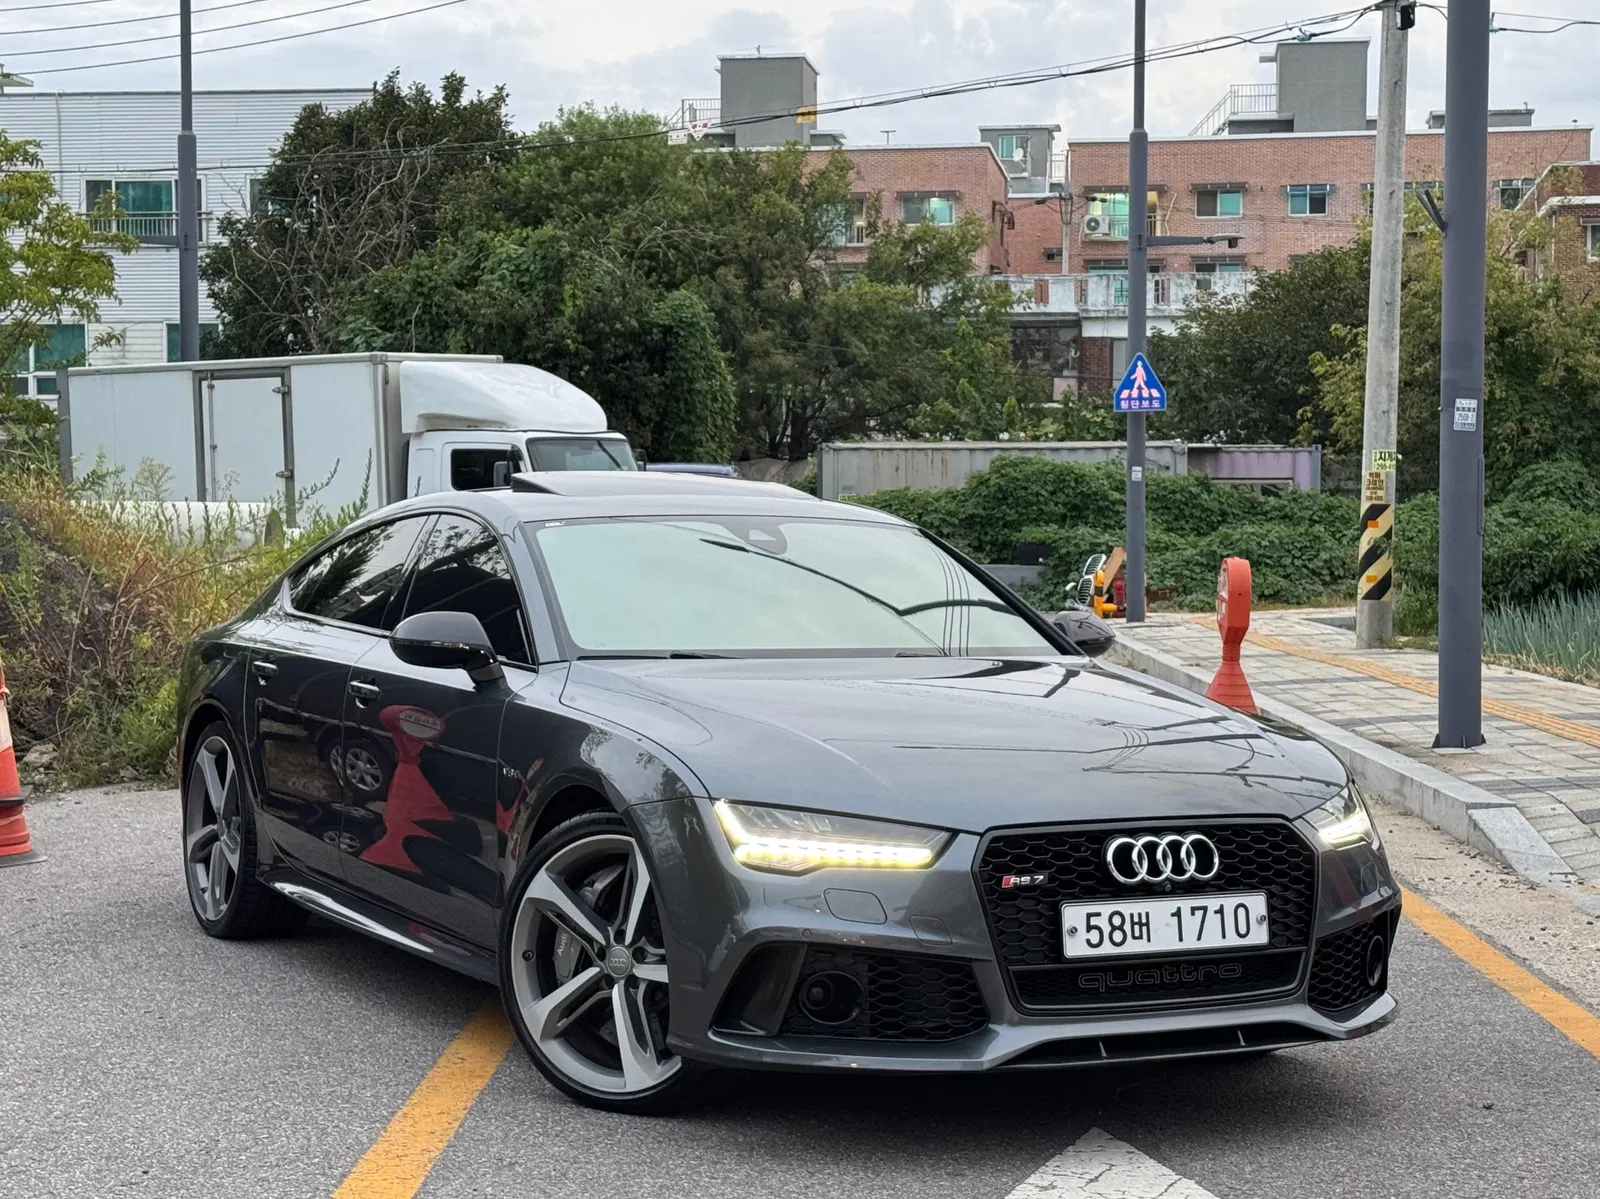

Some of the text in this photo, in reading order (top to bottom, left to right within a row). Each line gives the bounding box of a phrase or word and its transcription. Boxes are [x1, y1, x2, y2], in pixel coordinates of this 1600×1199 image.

[1120, 399, 1160, 409] 횡단보도
[1085, 902, 1251, 948] 58버 1710
[557, 932, 568, 956] Audi
[1078, 963, 1242, 992] quattro
